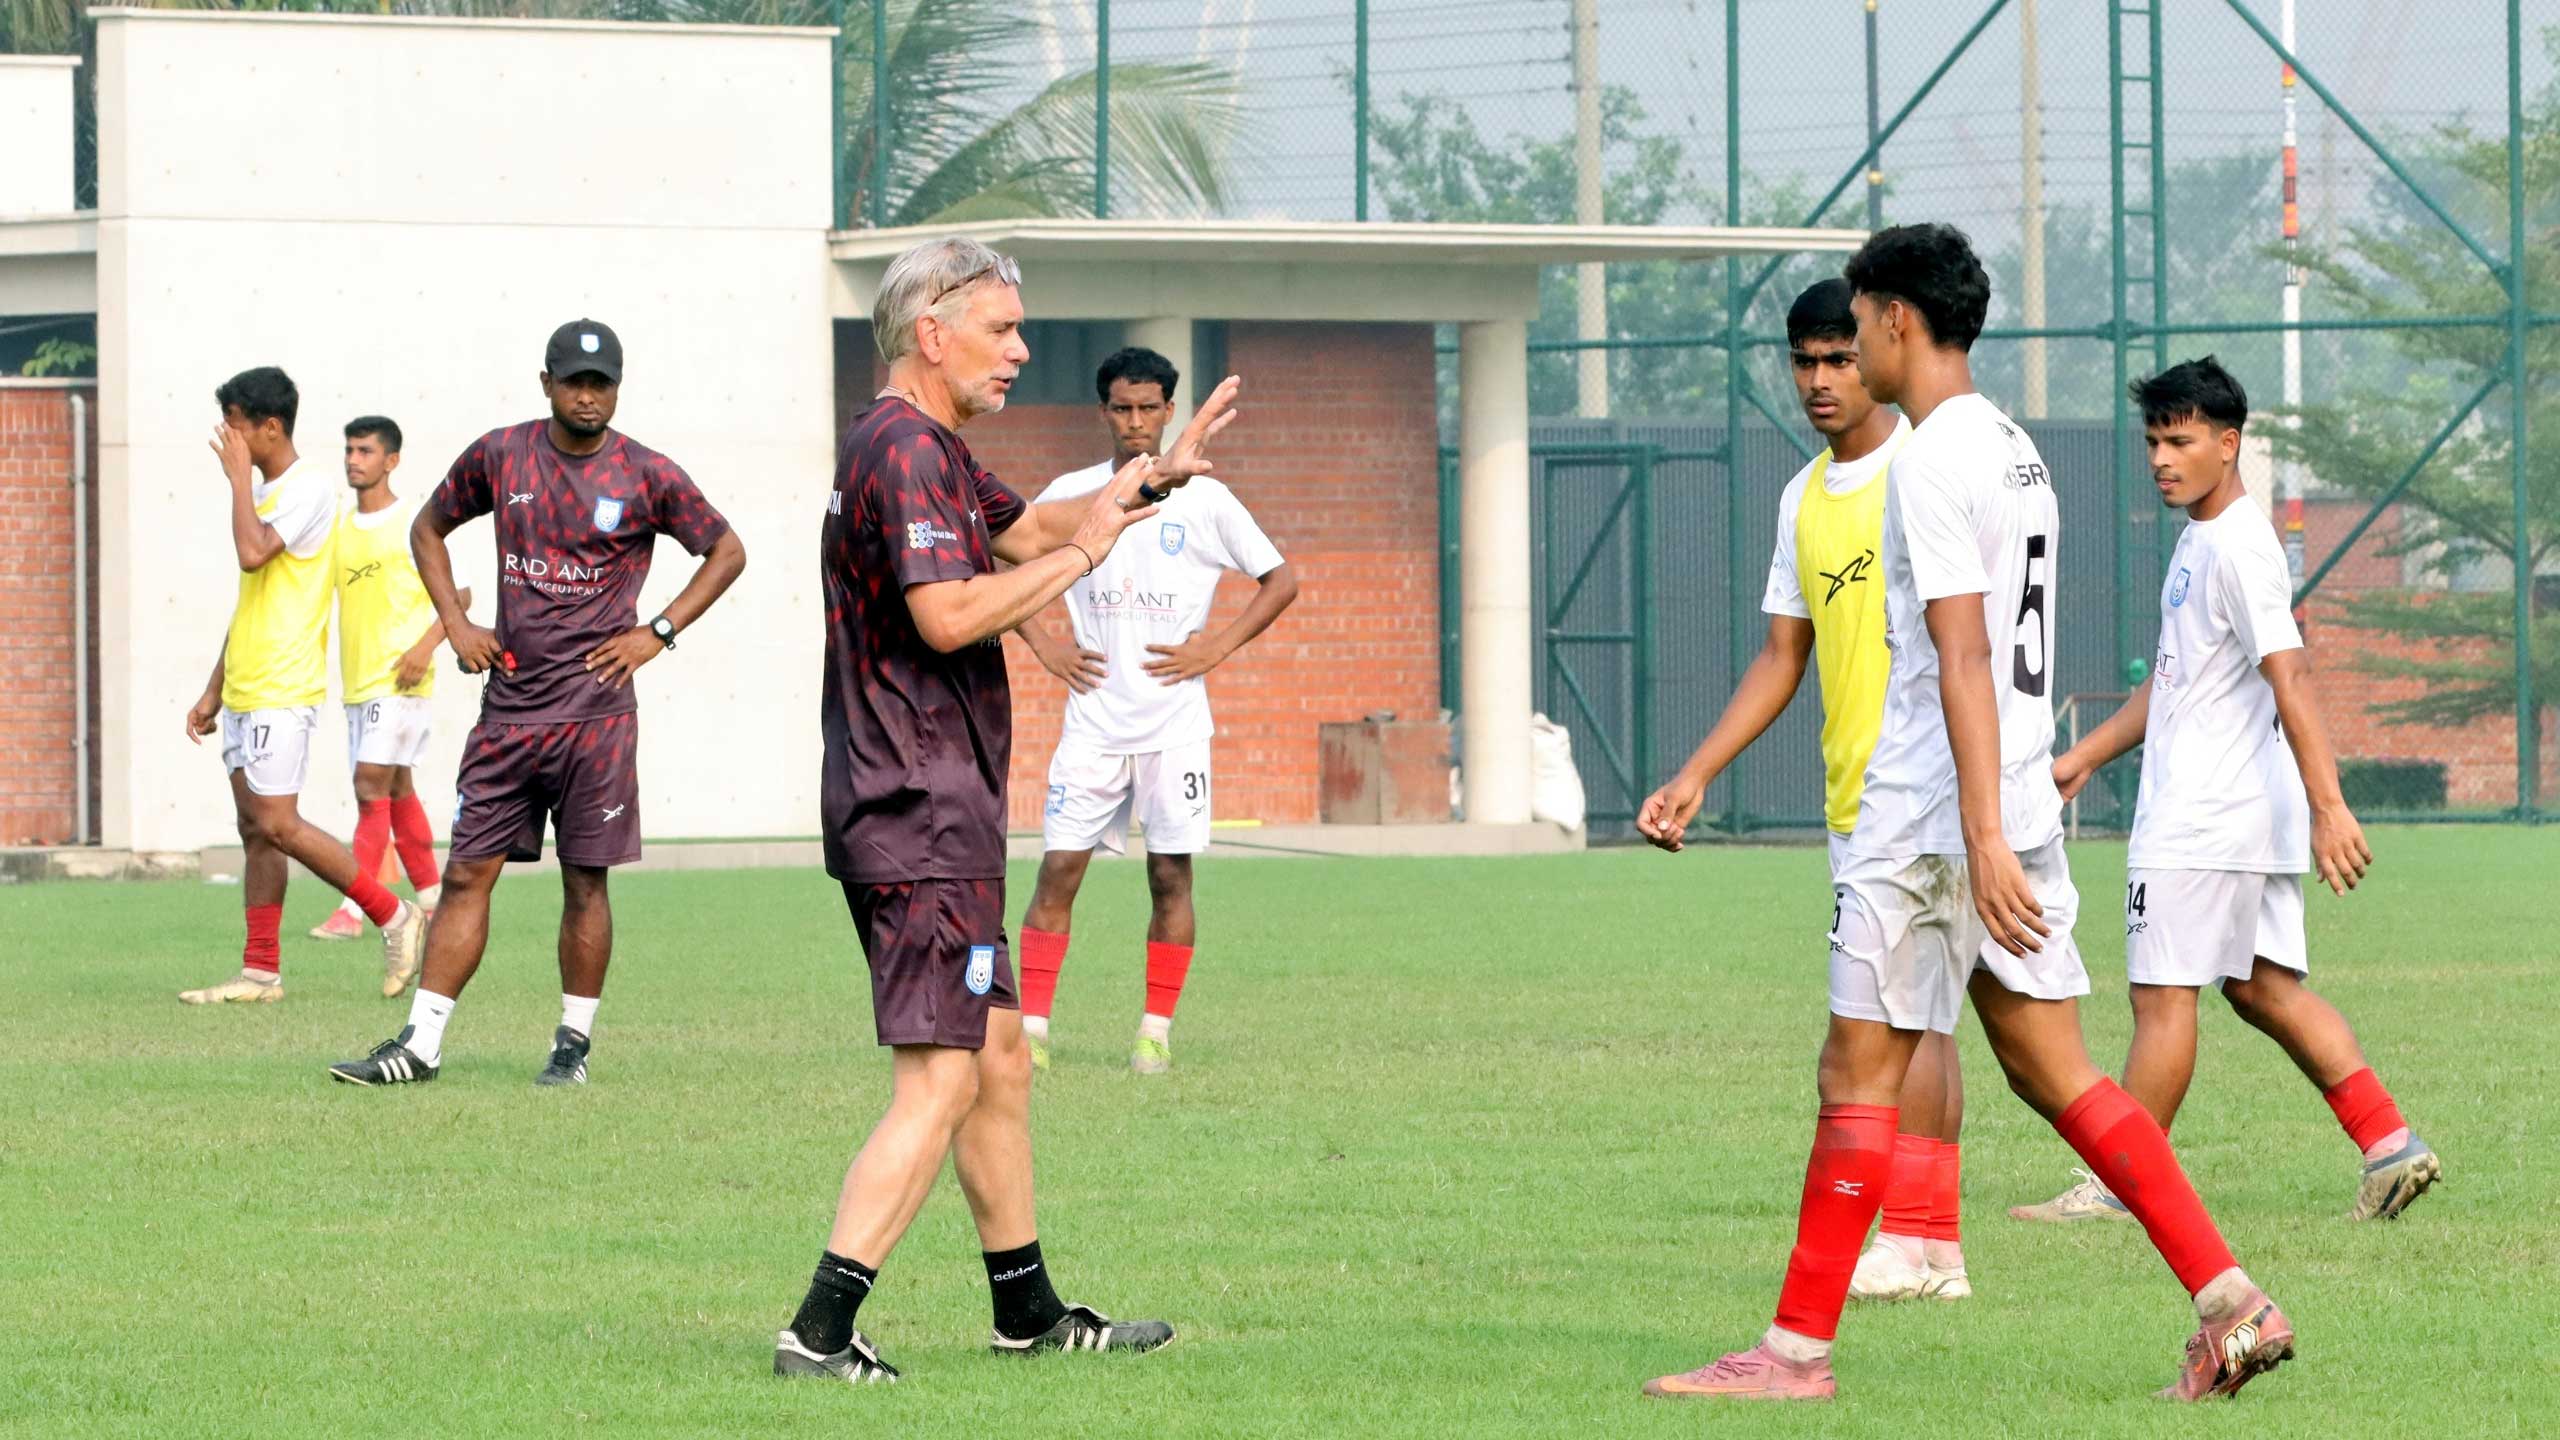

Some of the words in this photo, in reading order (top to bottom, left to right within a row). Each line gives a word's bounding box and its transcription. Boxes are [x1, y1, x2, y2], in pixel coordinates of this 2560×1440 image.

[504, 575, 603, 597] PHAMACEUTICAL
[2013, 534, 2046, 698] 5
[253, 725, 270, 749] 17
[1183, 771, 1206, 801] 31
[2128, 880, 2146, 917] 14
